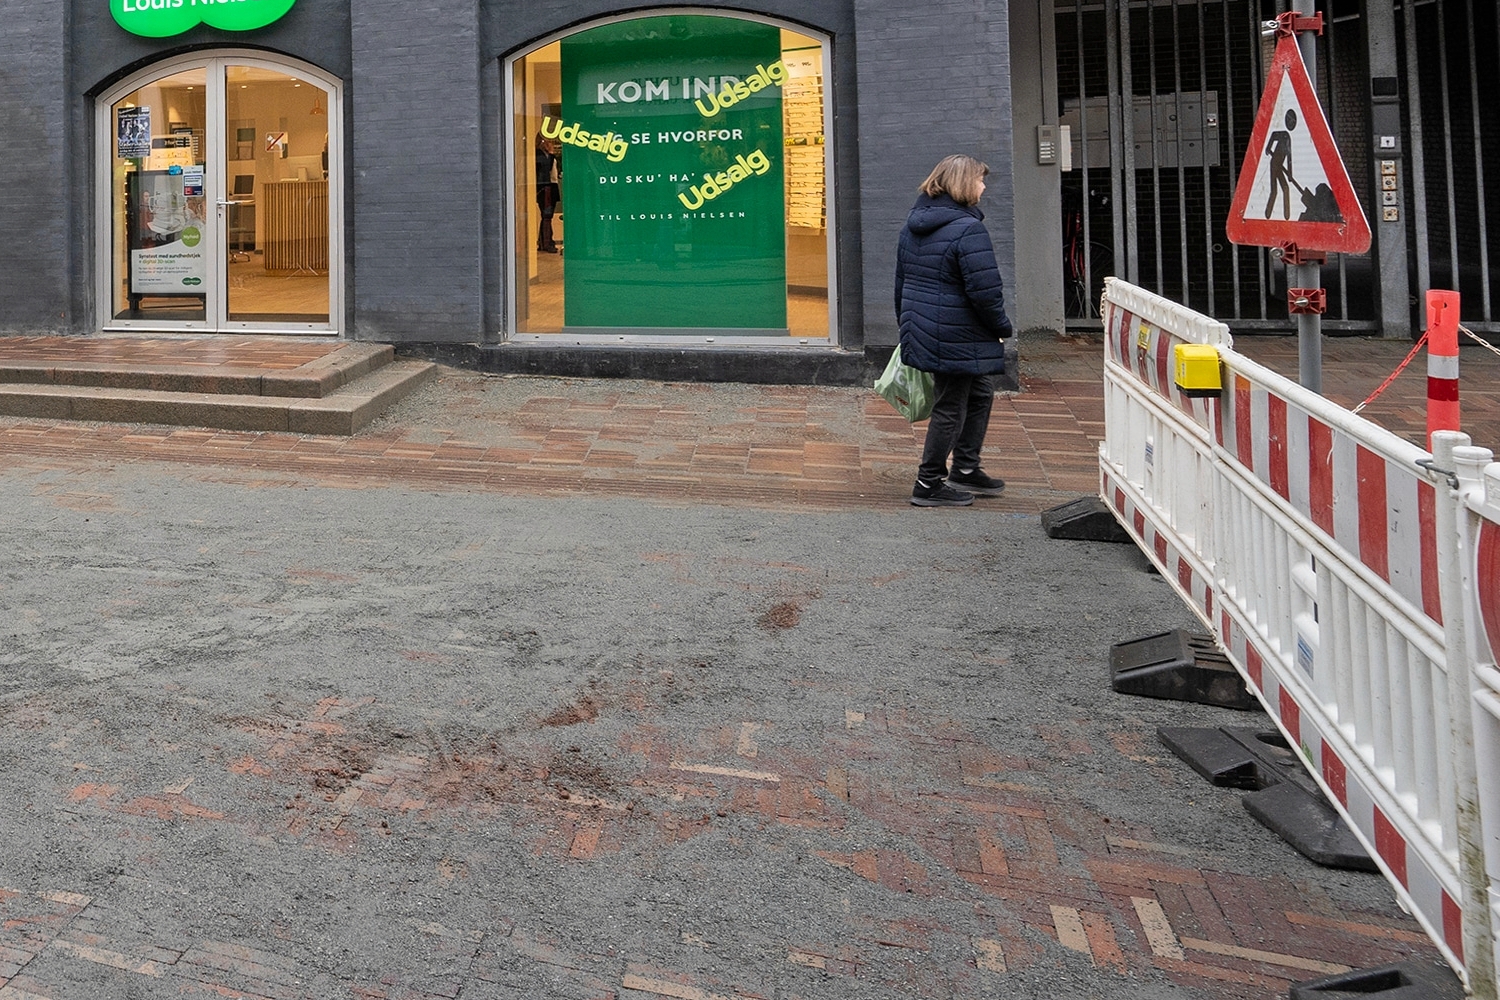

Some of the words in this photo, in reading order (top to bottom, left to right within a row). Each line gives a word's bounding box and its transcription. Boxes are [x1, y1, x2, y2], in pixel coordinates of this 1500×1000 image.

[597, 79, 670, 104] KOM
[694, 60, 790, 117] Udsalg
[541, 116, 629, 162] Udsalg
[631, 133, 650, 145] SE
[658, 129, 743, 143] HVORFOR
[600, 175, 618, 184] DU
[625, 174, 661, 183] SKU'
[669, 172, 695, 182] HA'
[678, 149, 770, 210] Udsalg
[683, 211, 745, 219] NIELSEN
